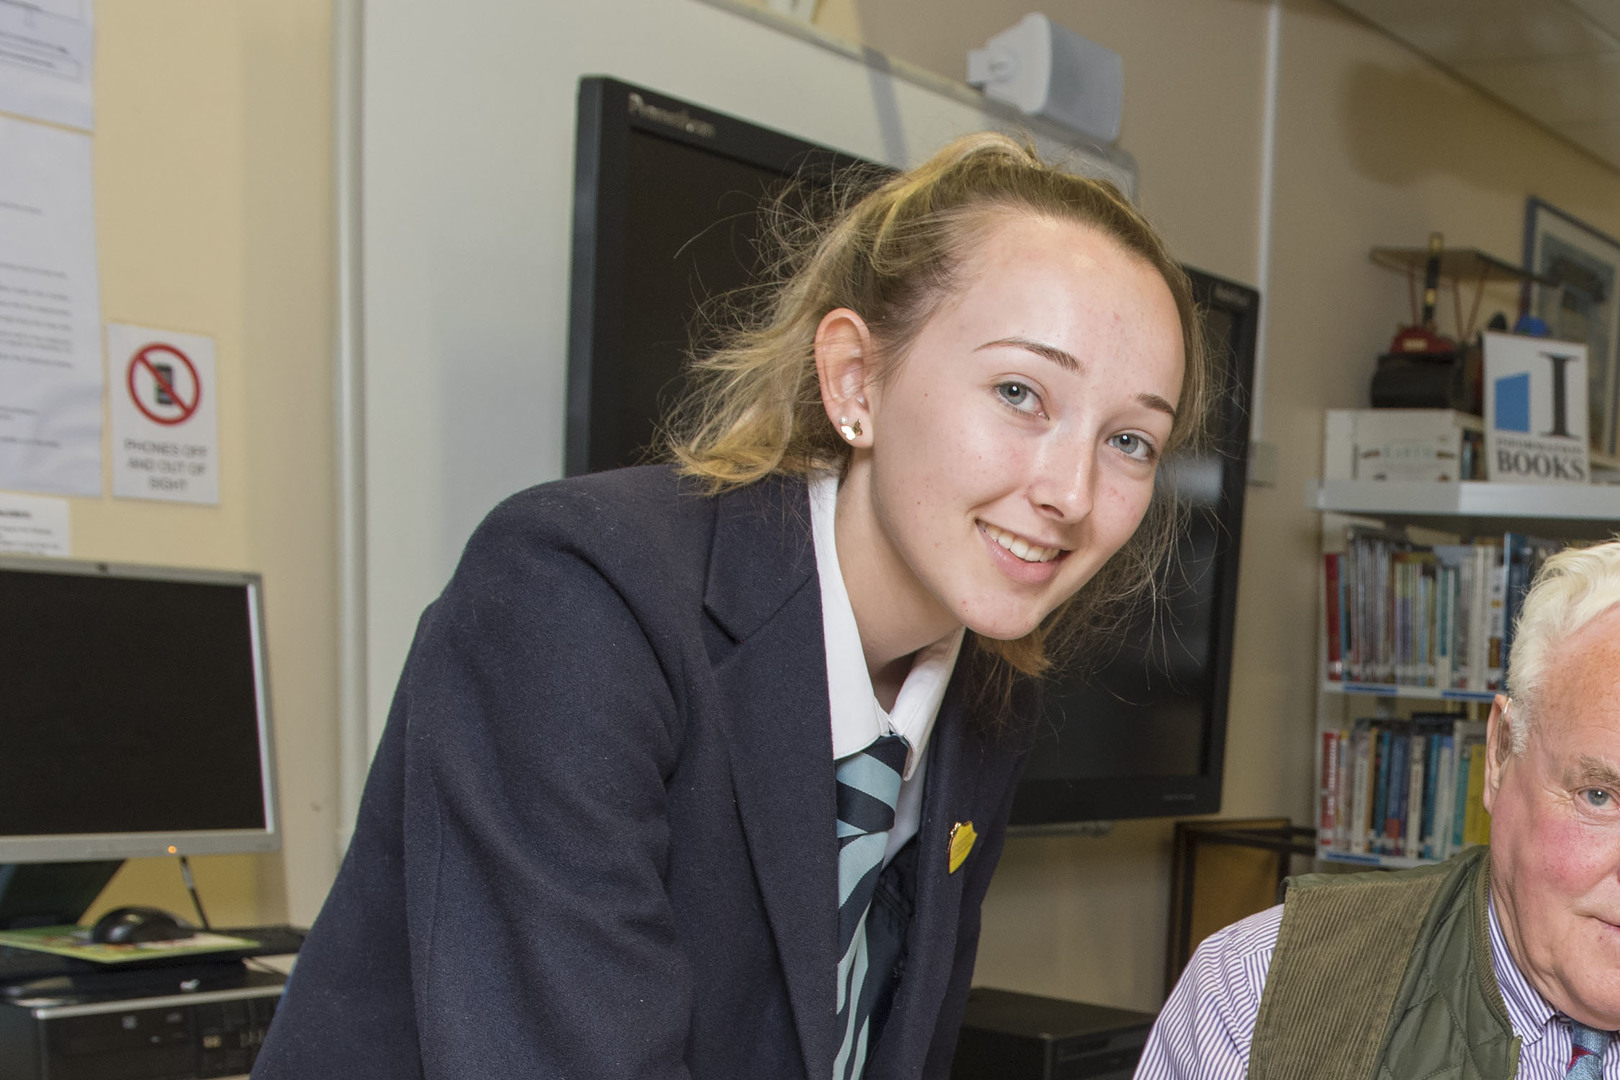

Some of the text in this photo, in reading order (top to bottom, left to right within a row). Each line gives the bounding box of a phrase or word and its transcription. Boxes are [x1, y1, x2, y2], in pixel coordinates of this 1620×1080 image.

[123, 438, 207, 459] PHONES OFF
[128, 457, 207, 477] AND OUT OF
[1496, 450, 1586, 481] BOOKS
[148, 475, 188, 491] SIGHT
